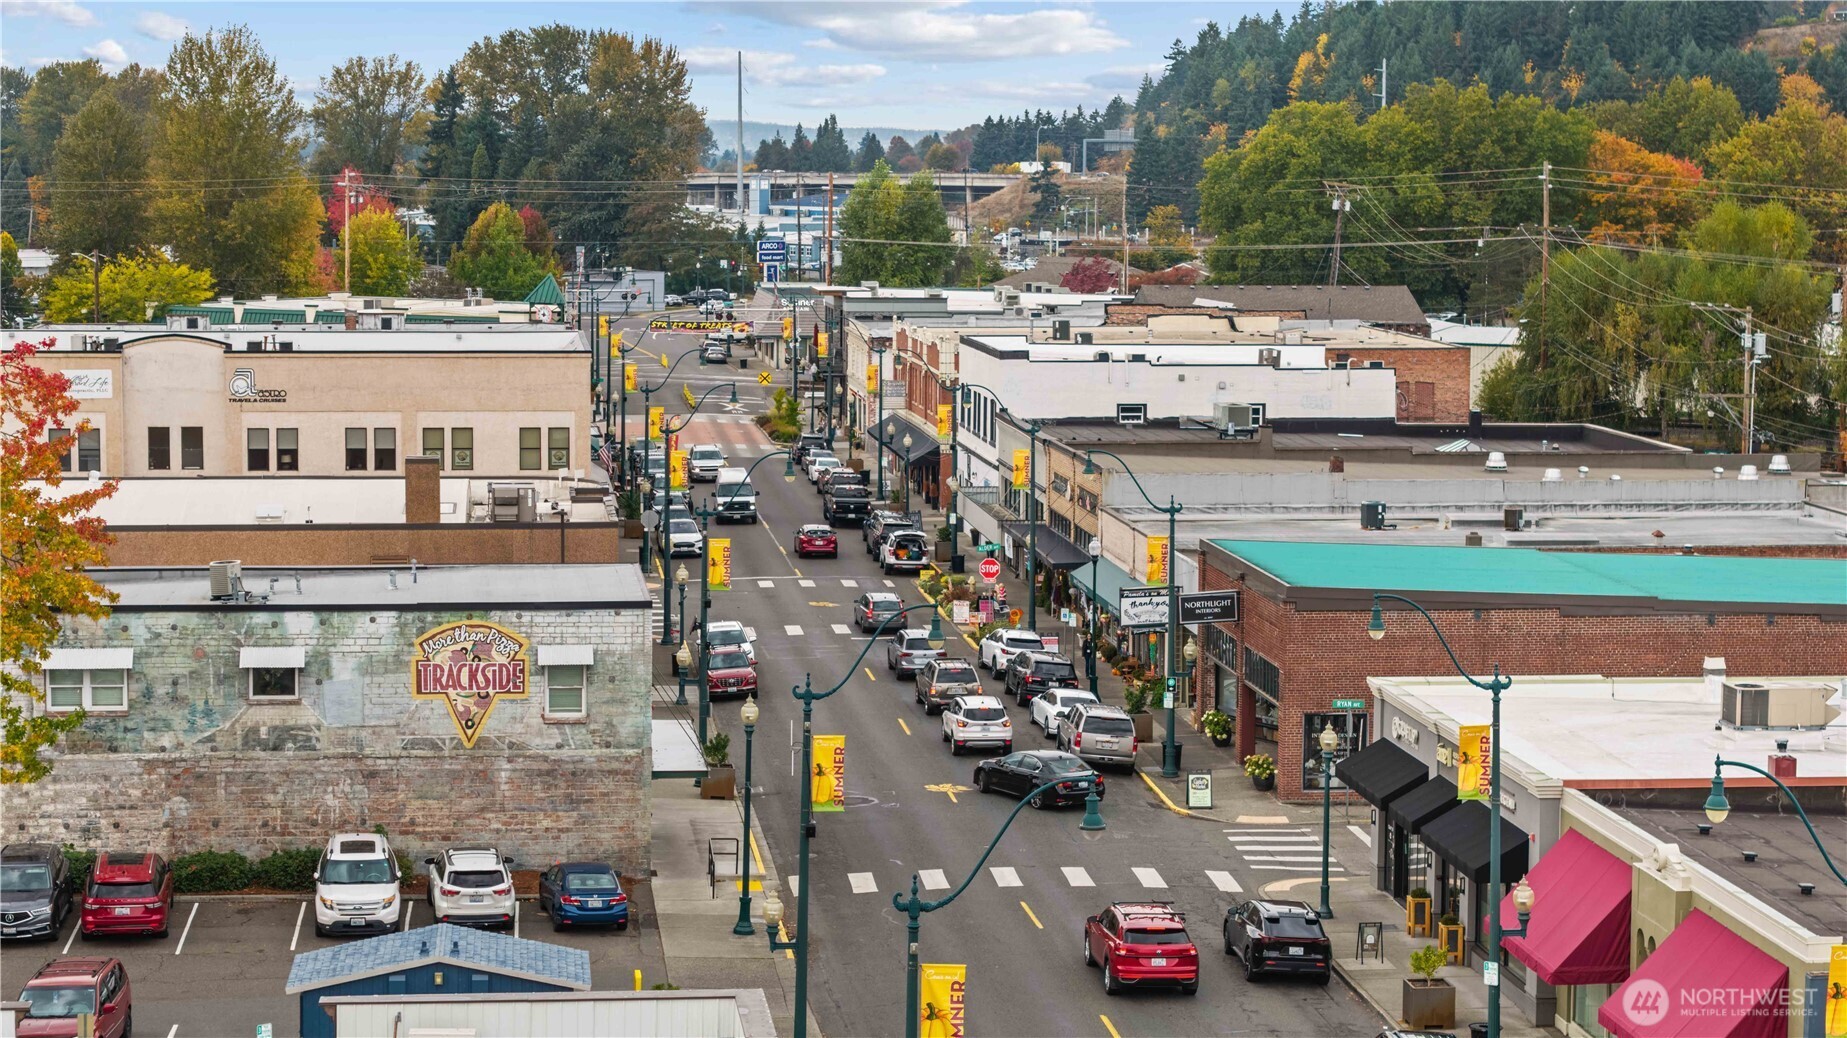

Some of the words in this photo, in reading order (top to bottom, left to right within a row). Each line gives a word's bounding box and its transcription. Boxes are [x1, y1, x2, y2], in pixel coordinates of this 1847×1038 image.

[651, 321, 684, 329] STRET
[700, 321, 732, 330] TREATS
[723, 546, 731, 588] SUMNER
[981, 564, 999, 573] STOP
[1161, 543, 1169, 584] SUMNER
[1129, 598, 1154, 609] thank
[1184, 600, 1231, 609] NORTHLIGHT
[423, 635, 455, 657] More
[453, 624, 487, 644] than
[486, 628, 520, 655] Pizza
[418, 661, 523, 692] TRACKSIDE
[1336, 700, 1352, 708] RYAN
[833, 746, 845, 807] SUMNER
[1480, 735, 1491, 795] SUMNER
[950, 980, 966, 1038] MNER
